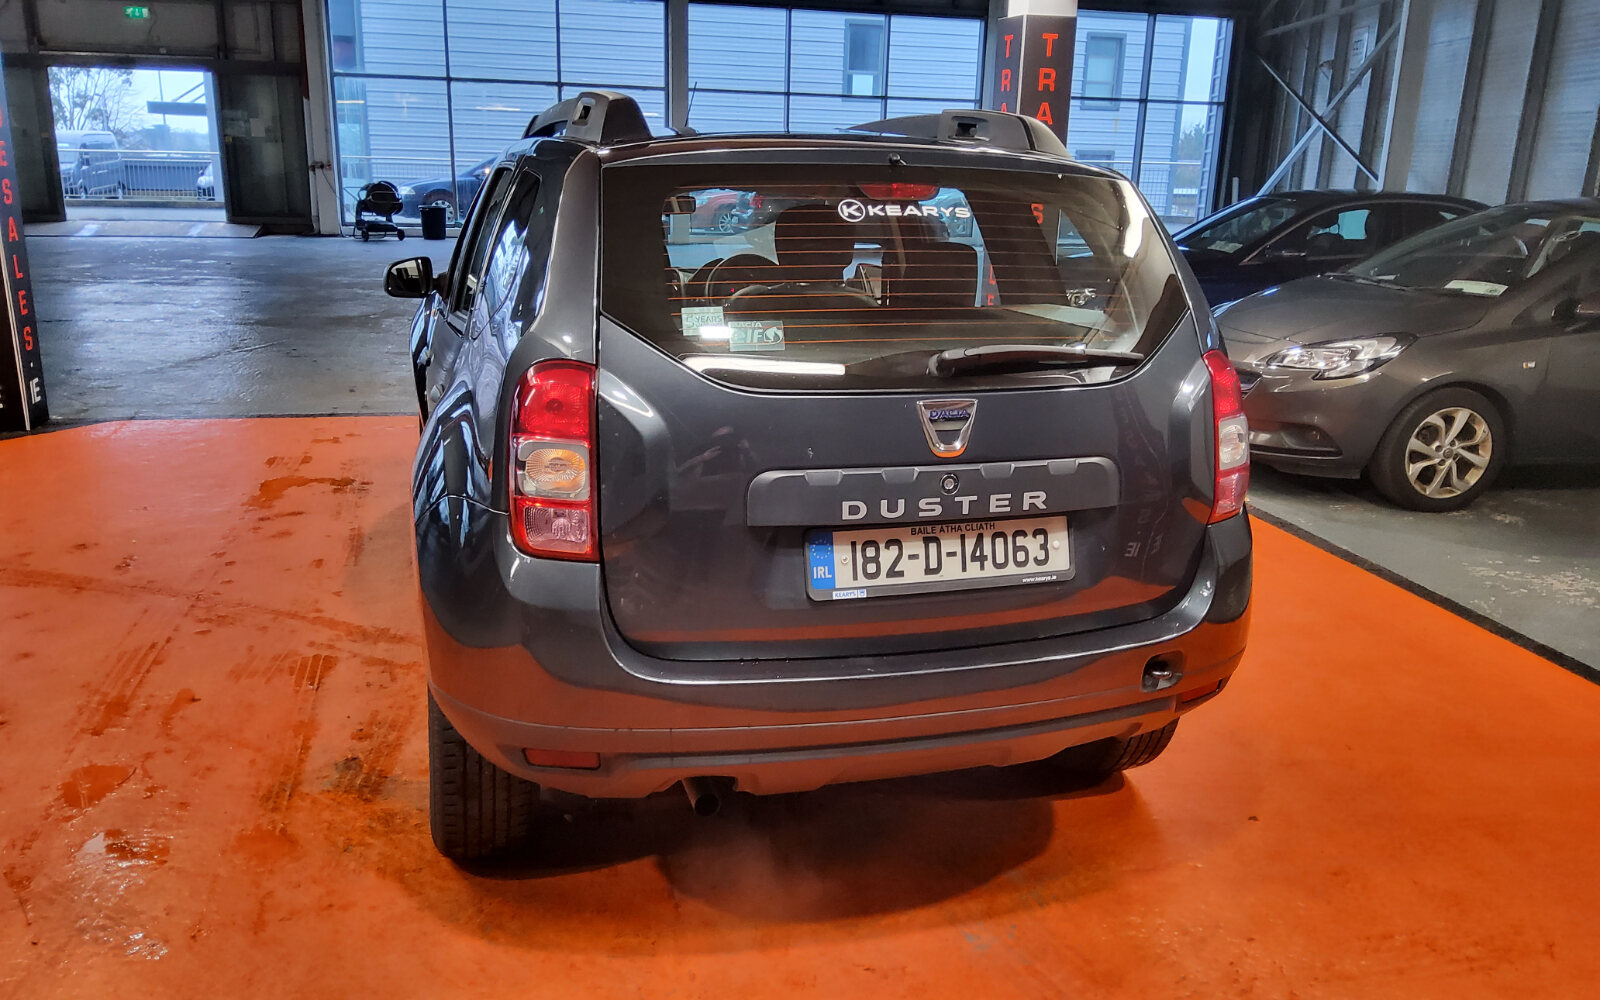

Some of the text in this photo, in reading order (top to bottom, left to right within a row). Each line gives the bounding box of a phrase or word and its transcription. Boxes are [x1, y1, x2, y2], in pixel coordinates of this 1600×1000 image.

[867, 204, 971, 218] KEARYS
[929, 409, 970, 420] DACIA
[841, 491, 1047, 521] DUSTER
[911, 526, 937, 536] BAILE
[964, 522, 996, 532] CLIATH
[850, 527, 1050, 581] 182-D-14063
[813, 565, 832, 579] IRL
